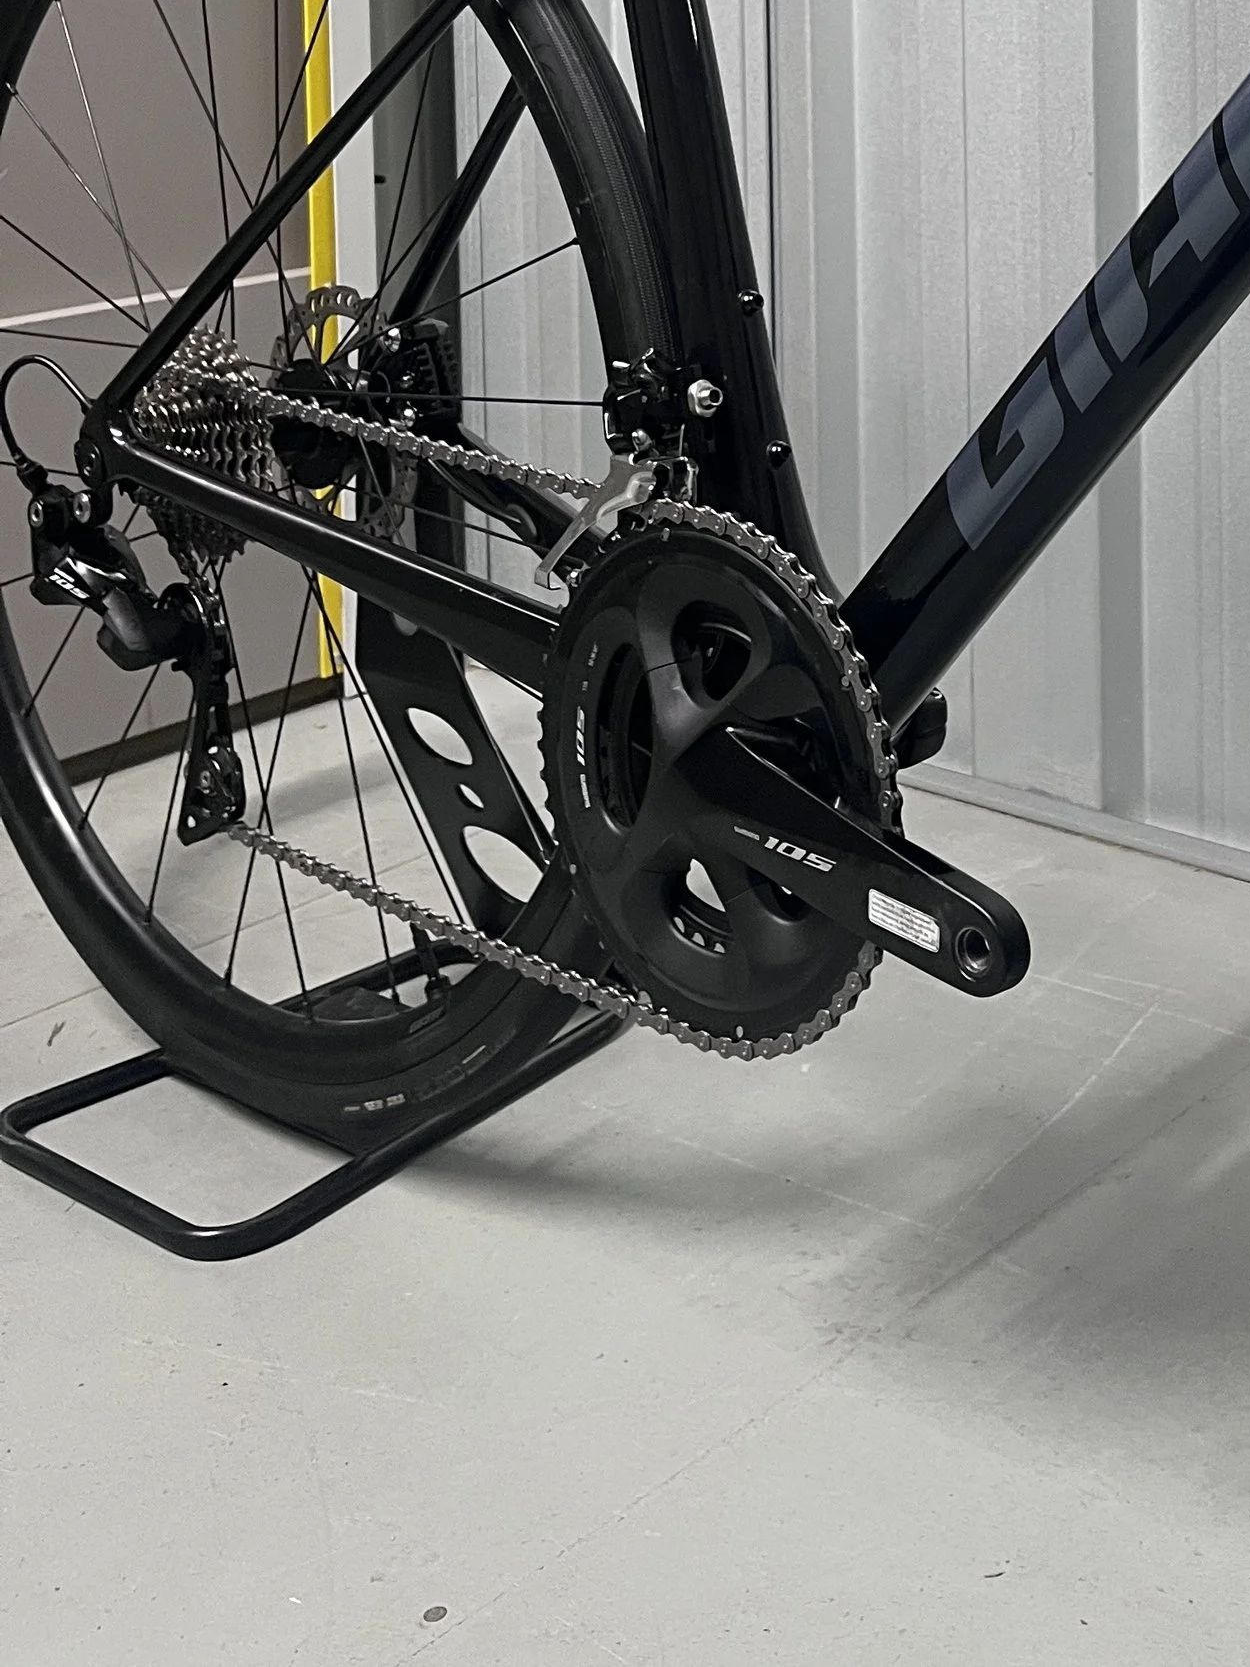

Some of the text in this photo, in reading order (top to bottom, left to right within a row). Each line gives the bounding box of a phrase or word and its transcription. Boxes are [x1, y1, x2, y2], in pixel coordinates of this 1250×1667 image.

[48, 572, 90, 599] 105
[576, 705, 587, 767] 105
[763, 835, 838, 872] 105
